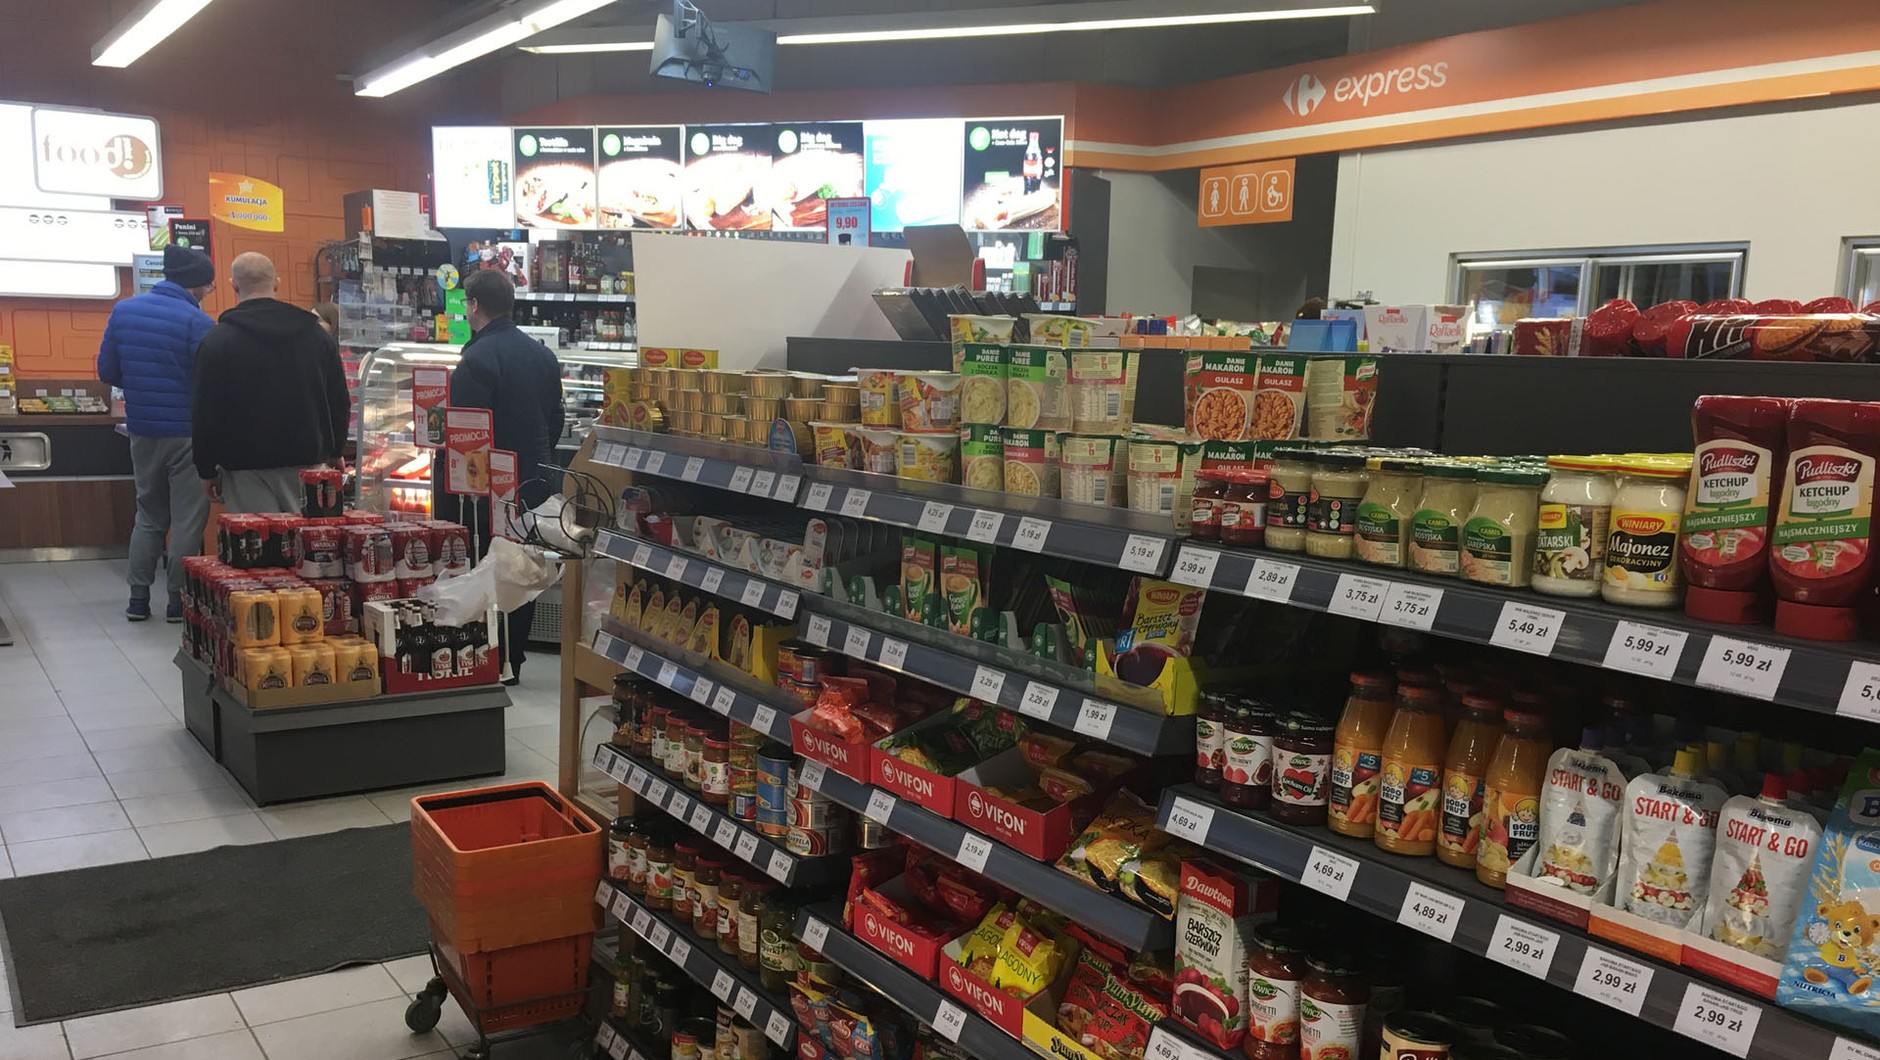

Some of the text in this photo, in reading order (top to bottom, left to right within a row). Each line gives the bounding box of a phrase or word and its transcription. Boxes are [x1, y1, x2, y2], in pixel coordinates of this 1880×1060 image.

[1334, 62, 1448, 107] express
[225, 195, 268, 206] KUMULACJA
[174, 223, 196, 231] Panini
[836, 216, 858, 230] 9,90
[1378, 314, 1408, 325] Raffaello
[1430, 324, 1465, 338] Raffaello
[976, 354, 999, 362] PUREE
[1012, 357, 1030, 365] PUREE
[1226, 357, 1246, 365] DANIE
[1205, 363, 1245, 373] MAKARON
[1261, 366, 1294, 375] AKARON
[1215, 377, 1243, 385] GULASZ
[1264, 378, 1292, 387] GULASZ
[416, 387, 446, 400] PROMOCJA
[450, 431, 489, 444] PROMOCJA
[1208, 452, 1245, 461] MAKARON
[1701, 453, 1756, 472] Pudliszki
[1797, 460, 1858, 478] Pudliszki
[1703, 477, 1749, 489] KETCHUP
[1710, 489, 1741, 499] łagodny
[1799, 486, 1850, 498] KETCHUP
[1806, 499, 1841, 509] łagodny
[1370, 512, 1390, 520] KAMIS
[1428, 518, 1448, 527] KAMIS
[1686, 512, 1757, 527] NAJSMACZNIEJSZY
[974, 519, 993, 531] 5,19 zł
[1480, 527, 1500, 537] KAMIS
[1621, 518, 1663, 533] WINIARY
[1779, 524, 1858, 539] NAJSMACZNIEJSZY
[1021, 528, 1041, 540] 5,19 zł
[312, 541, 338, 550] WARKA
[1467, 540, 1496, 551] SAREPSKA
[1537, 535, 1574, 548] TATARSKI
[1610, 535, 1670, 557] Majonez
[1130, 546, 1154, 559] 5,19 zł
[1180, 561, 1206, 575] 2,99 zł
[1610, 557, 1663, 568] DEKORACYJNY
[1259, 570, 1287, 585] 2,89 zł
[1346, 588, 1378, 604] 3,75 zł
[1394, 600, 1428, 616] 3,75 zł
[1137, 613, 1172, 626] Barszcz
[1138, 619, 1180, 635] czerwony
[1508, 619, 1549, 638] 5,49 zł
[1624, 635, 1670, 656] 5,99 zł
[1722, 650, 1773, 671] 5,99 zł
[979, 675, 999, 689] 2,29 zł
[1028, 693, 1049, 707] 2,29 zł
[1085, 710, 1107, 721] 1,99 zł
[812, 737, 848, 763] VIFON
[1333, 770, 1350, 780] BOBO
[1334, 777, 1348, 785] FRUT
[895, 769, 933, 798] VIFON
[1282, 777, 1302, 791] Kocham
[1551, 768, 1621, 801] START & GO
[1382, 786, 1402, 796] BOBO
[1382, 793, 1400, 801] FRUT
[1658, 785, 1703, 800] Bakoma
[1446, 799, 1466, 810] BOBO
[1446, 805, 1464, 815] FRUT
[983, 804, 1025, 836] VIFON
[1635, 797, 1718, 829] START & GO
[1750, 808, 1792, 827] Bakoma
[1172, 813, 1197, 831] 4,69 zł
[1513, 823, 1539, 832] BOBO
[1726, 819, 1809, 858] START & GO
[965, 843, 984, 855] 2,19 zł
[1313, 862, 1344, 881] 4,69 zł
[1187, 876, 1232, 909] Dawtona
[1412, 902, 1448, 925] 4,89 zł
[1188, 918, 1222, 946] BARSZCZ
[878, 925, 914, 957] VIFON
[1185, 931, 1220, 957] CZERWONY
[1504, 937, 1544, 960] 2,99 zł
[1592, 969, 1637, 995] 2,99 zł
[1793, 980, 1836, 999] NUTRICIA
[964, 978, 1004, 1016] VIFON
[1103, 975, 1165, 1021] YumYum
[953, 1018, 960, 1026] zł
[1694, 1005, 1743, 1034] 2,99 zł
[1155, 1044, 1172, 1059] 4,69
